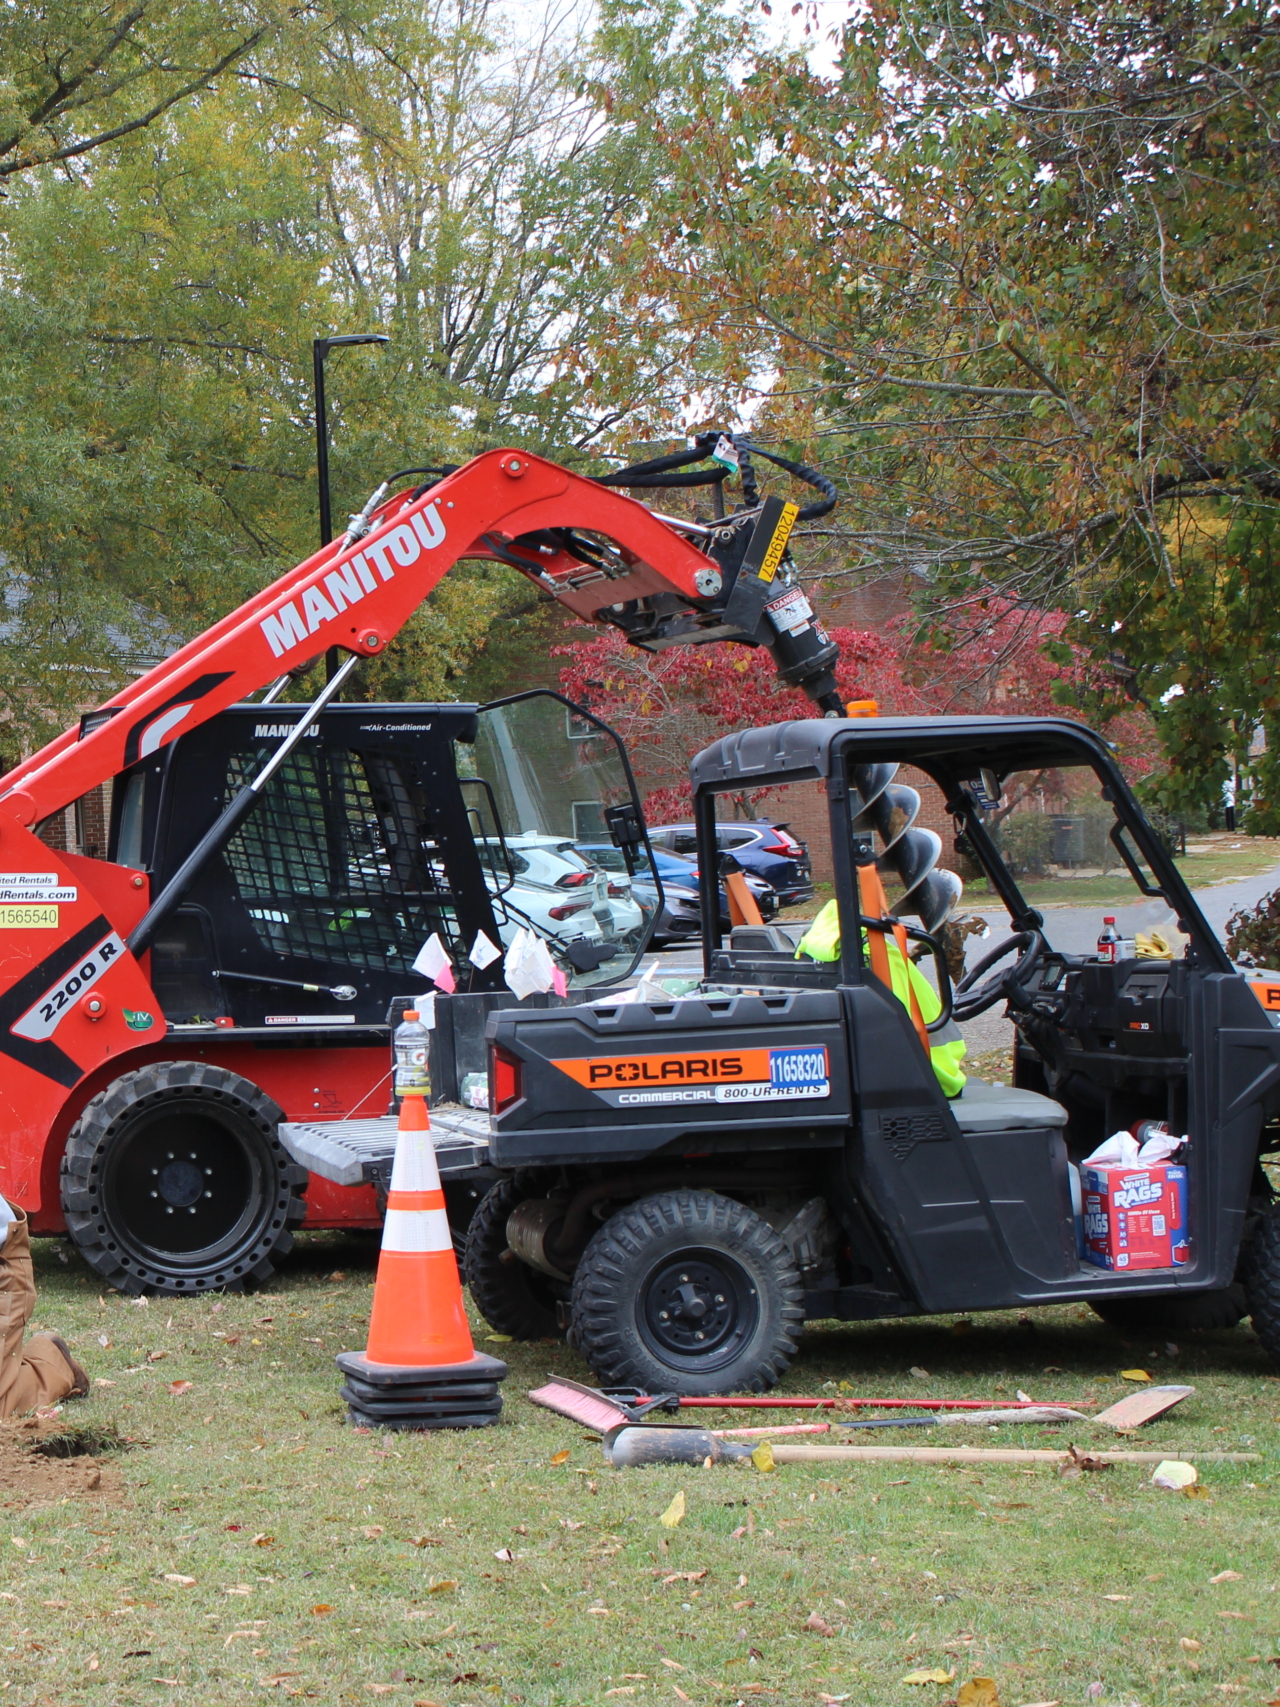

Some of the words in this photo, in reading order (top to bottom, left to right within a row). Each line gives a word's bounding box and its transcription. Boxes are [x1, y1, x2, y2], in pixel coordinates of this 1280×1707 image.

[762, 509, 795, 579] 12049457
[260, 505, 447, 658] MANITOU
[371, 723, 432, 732] Air-Conditioned
[19, 876, 52, 884] Rentals
[39, 962, 97, 1023] 2200
[99, 942, 118, 962] R
[589, 1058, 744, 1083] POLARIS
[770, 1054, 825, 1083] 11658320
[619, 1089, 717, 1104] COMMERCIAL
[1113, 1182, 1163, 1209] RAGS
[1119, 1178, 1150, 1190] WHITE
[1084, 1213, 1108, 1239] RAGS
